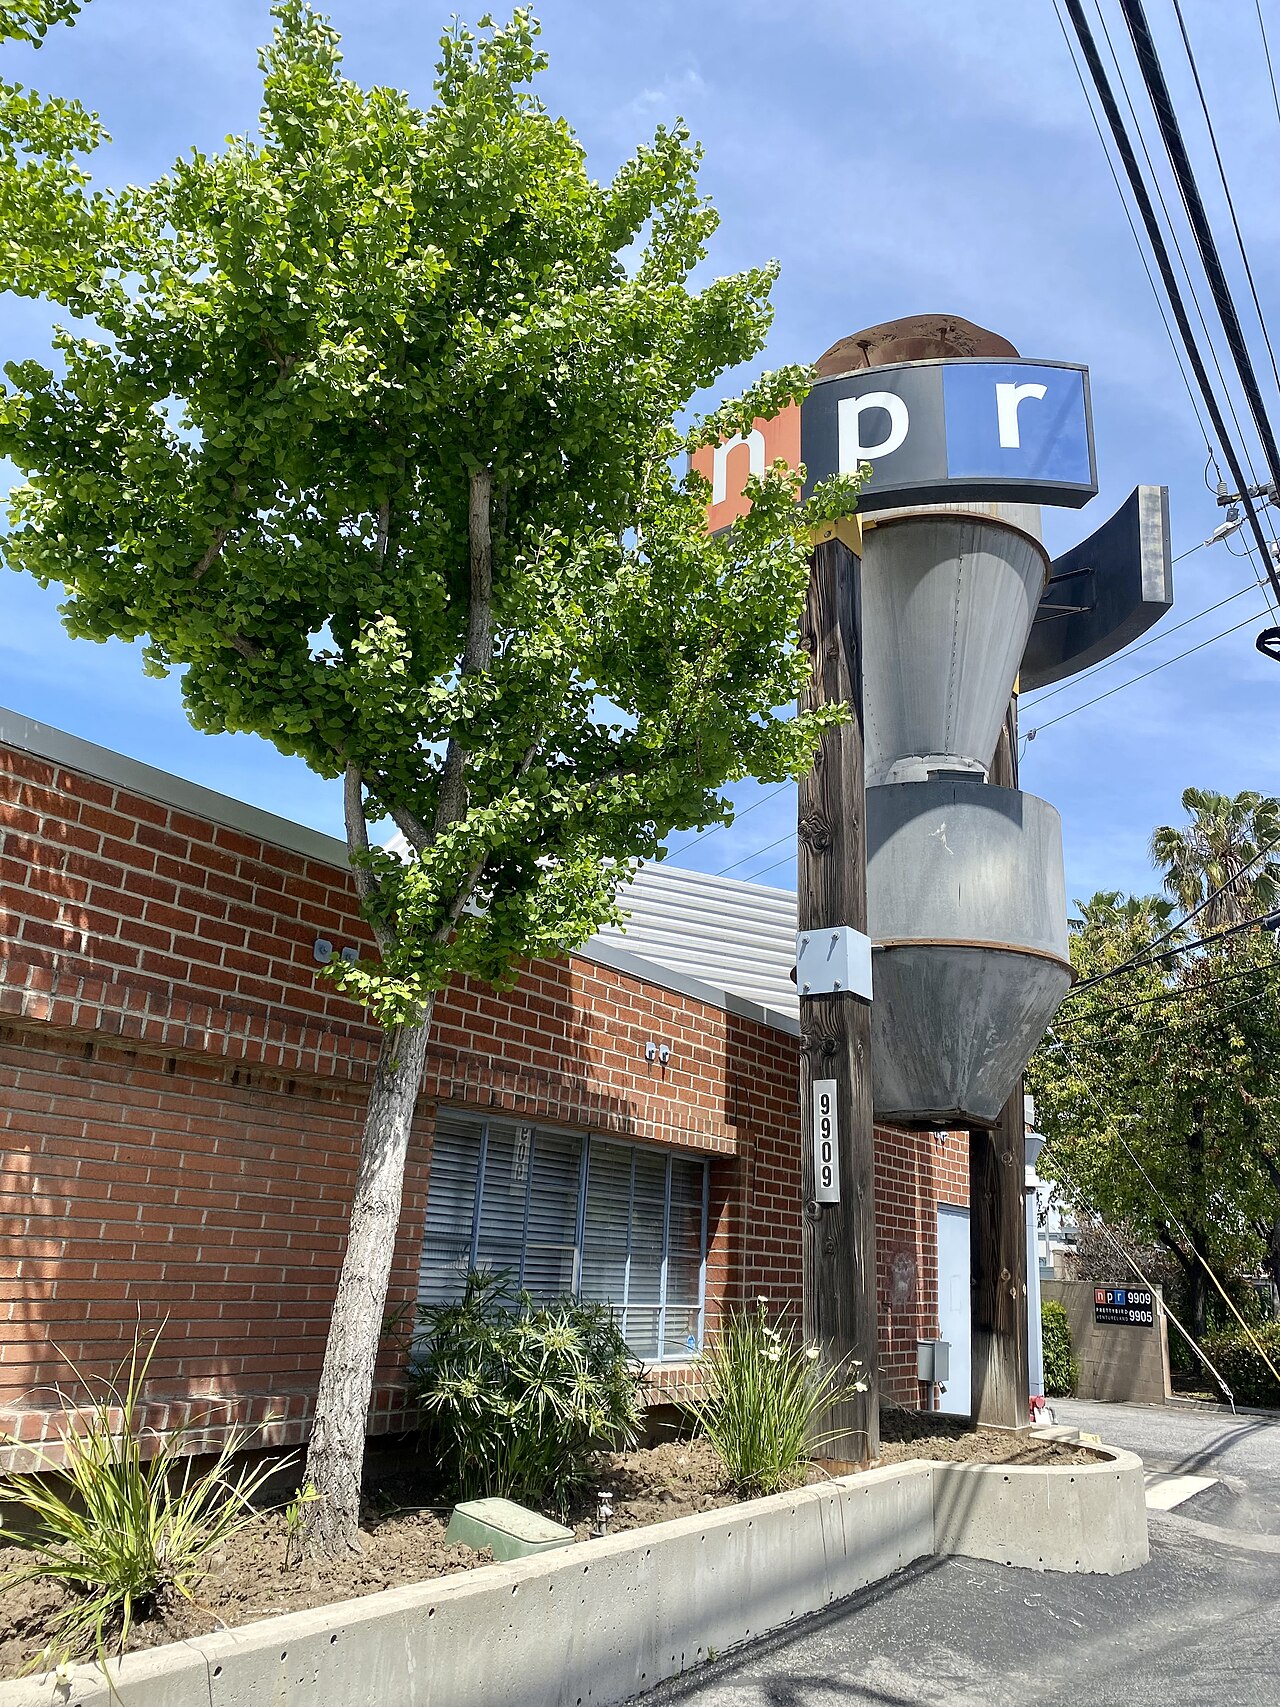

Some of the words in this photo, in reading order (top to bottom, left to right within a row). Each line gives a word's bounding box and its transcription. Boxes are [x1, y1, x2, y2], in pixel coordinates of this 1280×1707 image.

[712, 381, 1048, 506] npr
[820, 1093, 832, 1188] 9909
[1097, 1291, 1122, 1304] npr
[1127, 1292, 1151, 1305] 9909
[1128, 1310, 1153, 1323] 9905
